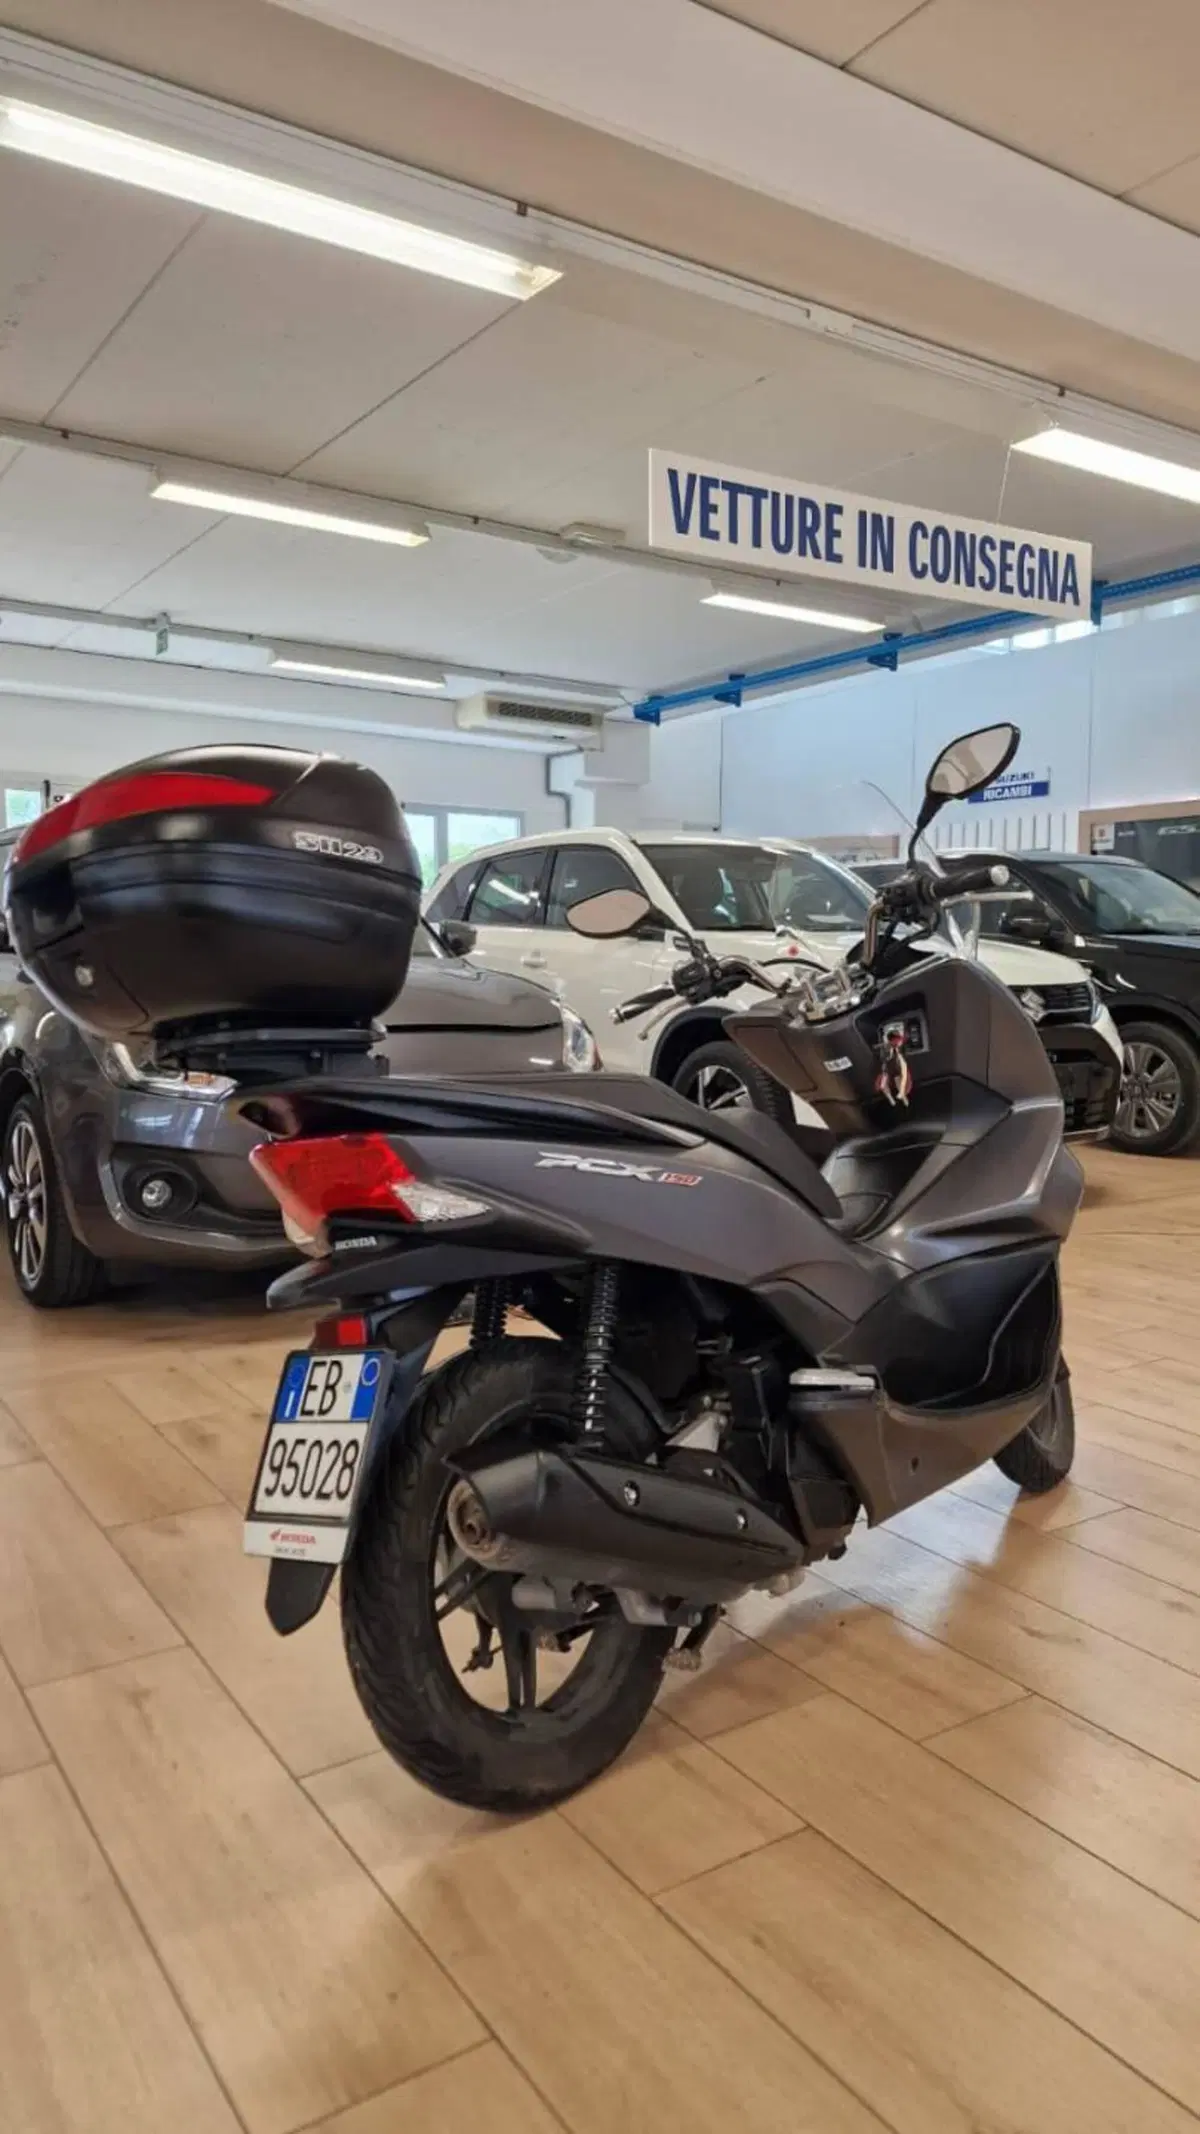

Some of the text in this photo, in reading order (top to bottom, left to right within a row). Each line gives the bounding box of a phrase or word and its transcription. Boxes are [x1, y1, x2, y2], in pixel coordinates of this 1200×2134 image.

[667, 468, 1081, 606] VETTURE IN CONSEGNA
[983, 784, 1032, 801] RICAMBI
[534, 1152, 664, 1182] PCX
[335, 1236, 377, 1250] HONDA
[300, 1360, 344, 1416] EB
[264, 1439, 360, 1500] 95028
